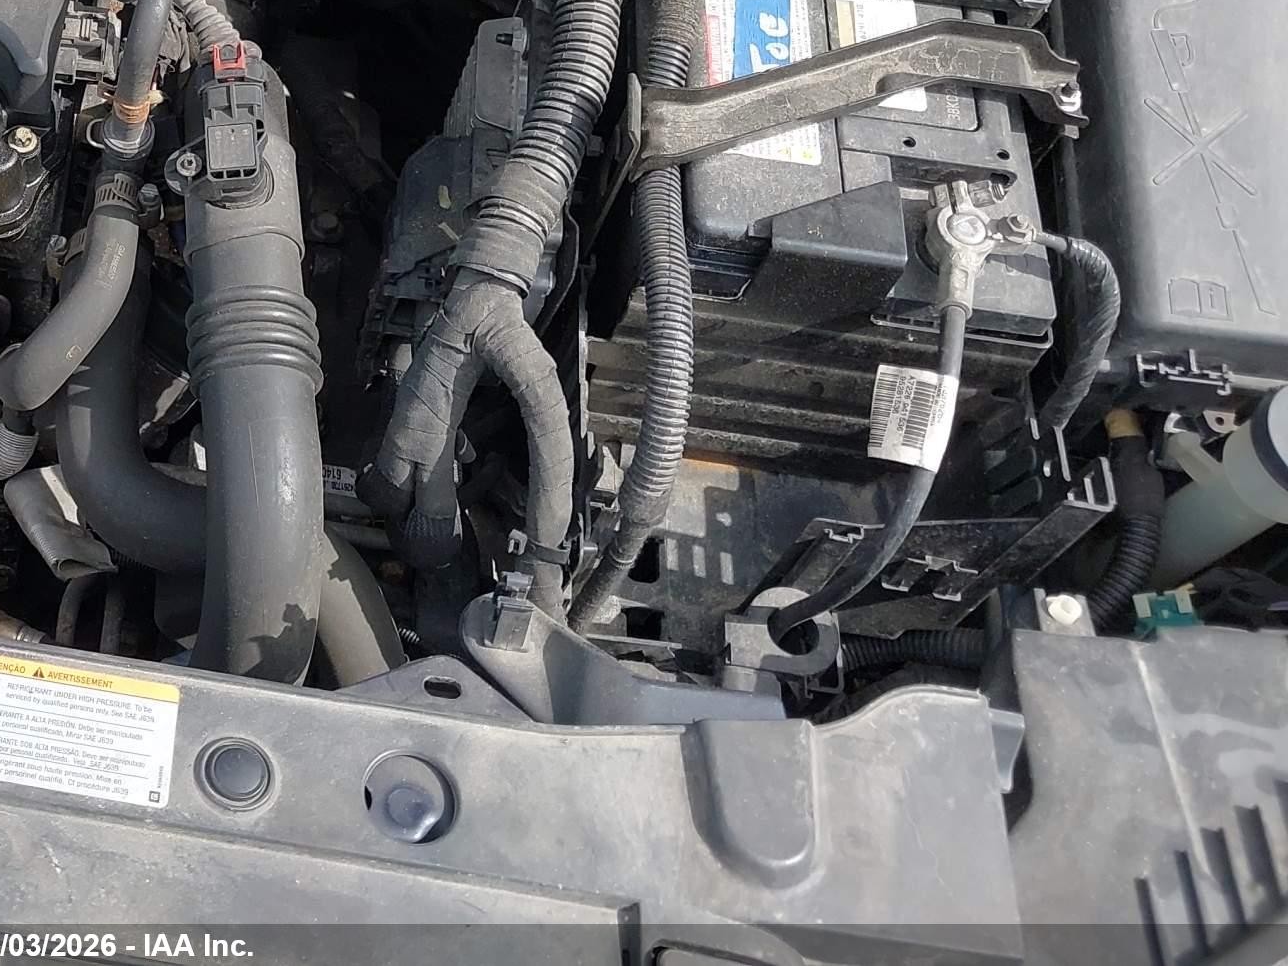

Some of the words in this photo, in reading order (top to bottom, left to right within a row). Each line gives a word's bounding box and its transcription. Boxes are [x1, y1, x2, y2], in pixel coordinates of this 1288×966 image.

[48, 671, 112, 687] AVERTISSEMENT
[7, 683, 52, 695] REFRIGERANT
[53, 691, 77, 699] UNDER
